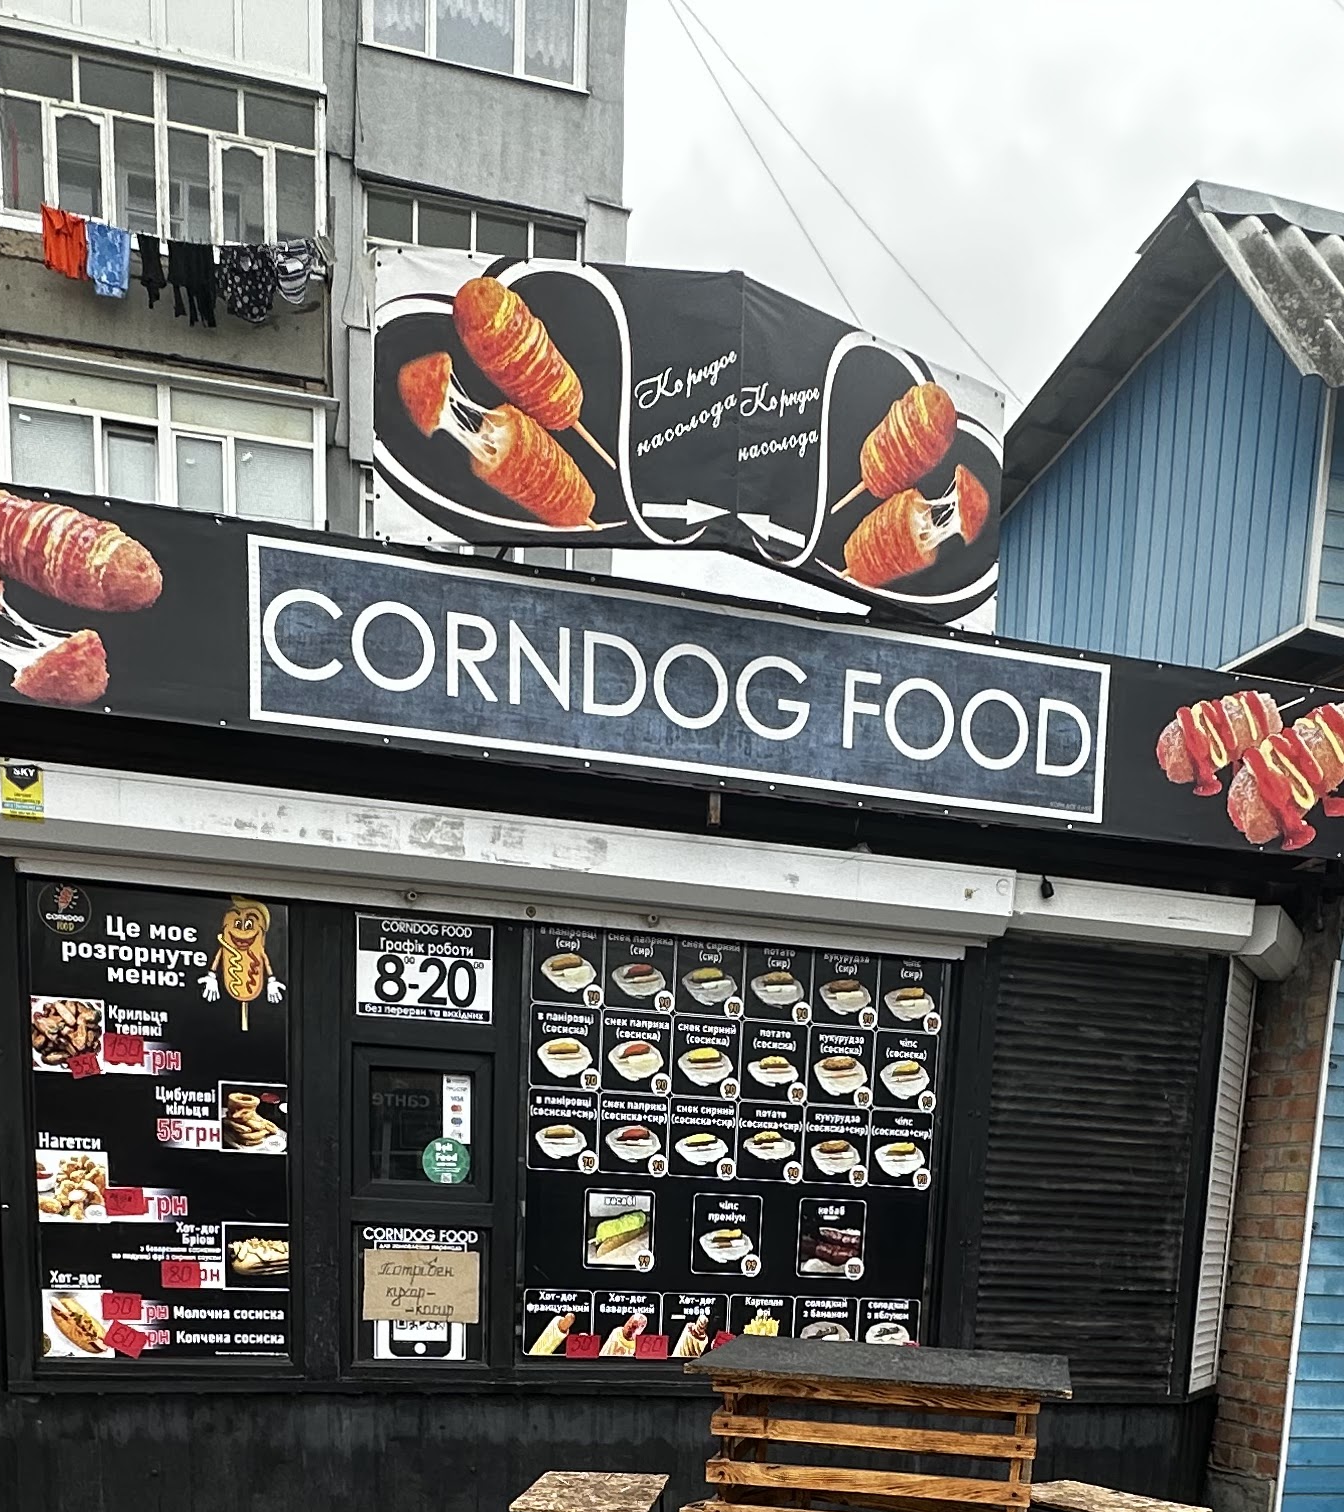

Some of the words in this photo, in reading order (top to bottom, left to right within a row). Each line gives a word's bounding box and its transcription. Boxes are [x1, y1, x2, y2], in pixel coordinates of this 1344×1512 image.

[636, 393, 738, 457] насолода
[738, 428, 819, 462] насолода
[261, 588, 811, 742] CORNDOG
[841, 668, 1092, 778] FOOD
[13, 768, 36, 777] SKY
[106, 915, 141, 942] Це
[149, 924, 198, 942] моє
[381, 921, 439, 937] CORNDOG
[441, 926, 472, 938] FOOD
[380, 937, 425, 955] Графік
[427, 943, 474, 957] роботи
[555, 937, 581, 951] (сир)
[61, 942, 208, 968] розгорнуте
[630, 945, 654, 958] (сир)
[699, 951, 722, 963] (сир)
[767, 957, 791, 970] (сир)
[835, 963, 858, 975] (сир)
[107, 967, 186, 988] меню:
[900, 968, 923, 981] (сир)
[108, 1005, 168, 1024] Крильця
[364, 1003, 383, 1013] без
[384, 1005, 426, 1017] перерви
[429, 1009, 440, 1017] та
[442, 1009, 484, 1021] вихідних
[546, 1012, 594, 1025] паніровці
[115, 1022, 162, 1037] теріякі
[542, 1023, 589, 1036] (сосиска)
[605, 1018, 627, 1026] снек
[629, 1019, 670, 1031] паприка
[677, 1023, 700, 1032] снек
[702, 1023, 737, 1035] сирний
[616, 1029, 661, 1042] (сосиска)
[686, 1034, 730, 1047] (сосиска)
[759, 1029, 792, 1039] потато
[819, 1034, 865, 1045] кукурудза
[752, 1039, 797, 1052] (сосиска)
[820, 1044, 862, 1056] (сосиска)
[886, 1049, 927, 1061] (сосиска)
[156, 1086, 216, 1103] Цибулеві
[544, 1096, 592, 1108] паніровці
[602, 1100, 625, 1109] снек
[627, 1101, 667, 1112] паприка
[166, 1103, 209, 1118] кільця
[530, 1106, 598, 1120] (сосиска+сир)
[677, 1105, 699, 1114] снек
[700, 1105, 735, 1117] сирний
[756, 1110, 787, 1119] потато
[601, 1111, 668, 1124] (сосиска+сир)
[671, 1115, 736, 1129] (сосиска+сир)
[815, 1113, 861, 1124] кукурудза
[738, 1120, 802, 1133] (сосиска+сир)
[806, 1123, 868, 1135] (сосиска+сир)
[872, 1127, 932, 1139] (сосиска+сир)
[38, 1132, 101, 1150] Нагетси
[818, 1205, 845, 1216] кебаб
[176, 1222, 220, 1235] Хот-дог
[363, 1227, 436, 1241] CORNDOG
[439, 1230, 478, 1243] FOOD
[182, 1234, 215, 1247] Бріош
[378, 1257, 455, 1285] Потрібен
[49, 1270, 102, 1286] Хот-дог
[539, 1291, 578, 1302] Хот-дог
[608, 1293, 647, 1304] Хот-дог
[679, 1295, 716, 1304] Хот-дог
[805, 1299, 848, 1309] солодкий
[868, 1301, 909, 1310] солодкий
[173, 1307, 230, 1321] Молочна
[233, 1308, 285, 1320] сосиска
[176, 1331, 230, 1346] Копчена
[234, 1332, 285, 1345] сосиска
